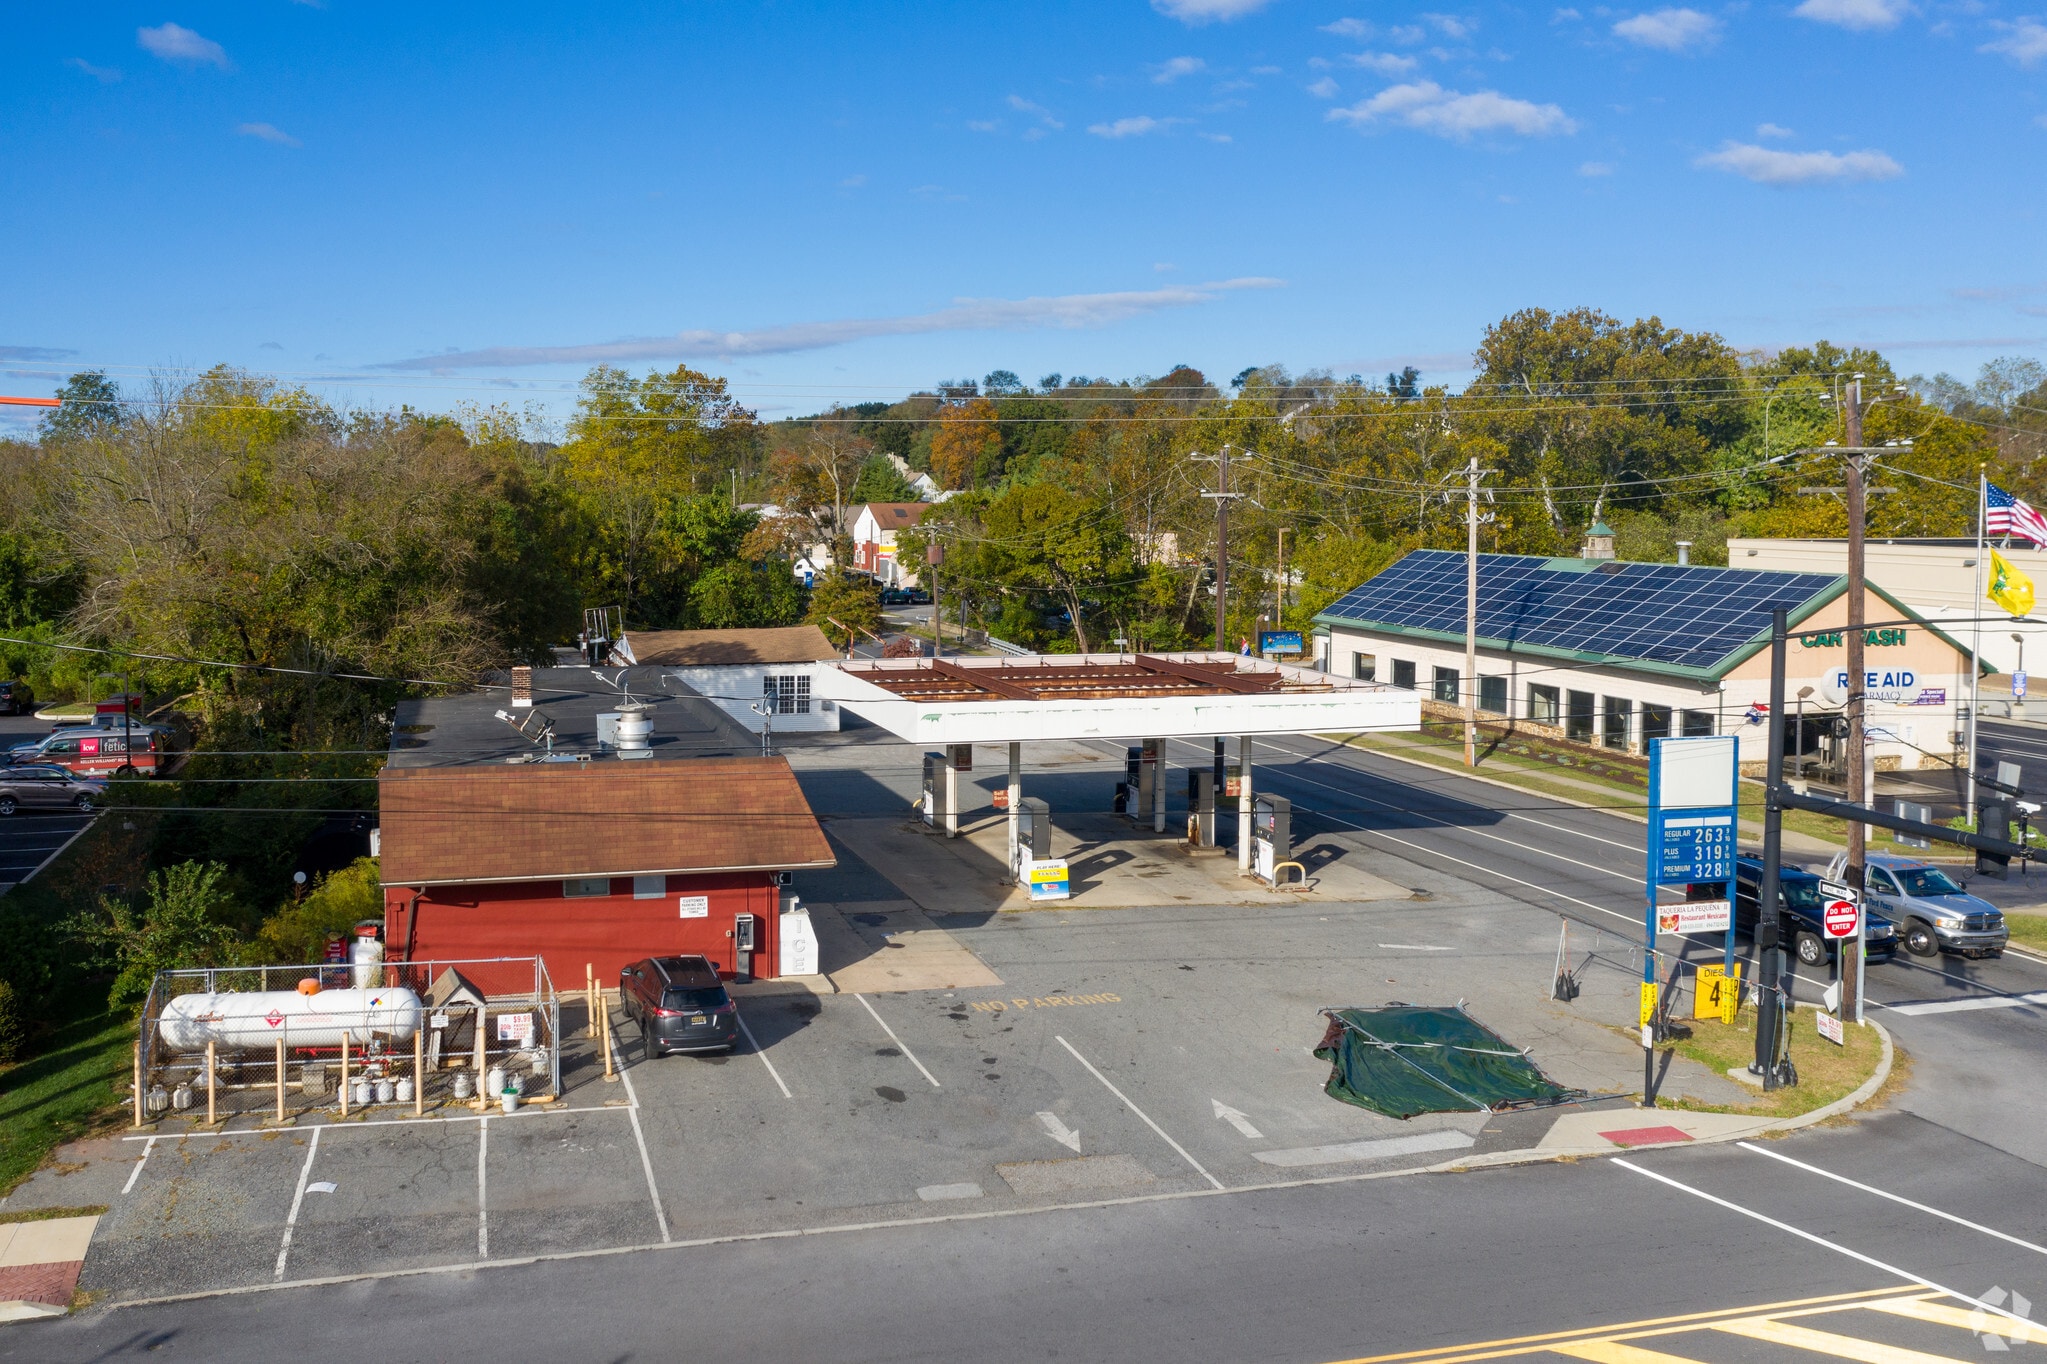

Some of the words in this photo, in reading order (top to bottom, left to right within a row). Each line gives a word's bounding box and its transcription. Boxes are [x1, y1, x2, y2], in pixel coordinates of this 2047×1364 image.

[1801, 633, 1843, 648] CAR
[1863, 629, 1907, 647] ASH
[1837, 673, 1878, 689] RE
[1882, 672, 1914, 688] AID
[1863, 690, 1902, 701] ARMACY
[83, 743, 96, 751] kw
[1664, 829, 1691, 838] REGULAR
[1695, 828, 1724, 844] 263
[1695, 845, 1722, 861] 319
[1663, 865, 1691, 873] PREMIUM
[1695, 862, 1722, 878] 328
[1659, 906, 1686, 914] TAQUERIA
[1687, 905, 1695, 913] LA
[1831, 923, 1851, 931] ENTER
[792, 918, 806, 973] ICE
[1704, 969, 1724, 977] DIES
[970, 1000, 1009, 1012] NO
[1011, 992, 1122, 1009] PARKING
[513, 1015, 531, 1023] $9.99
